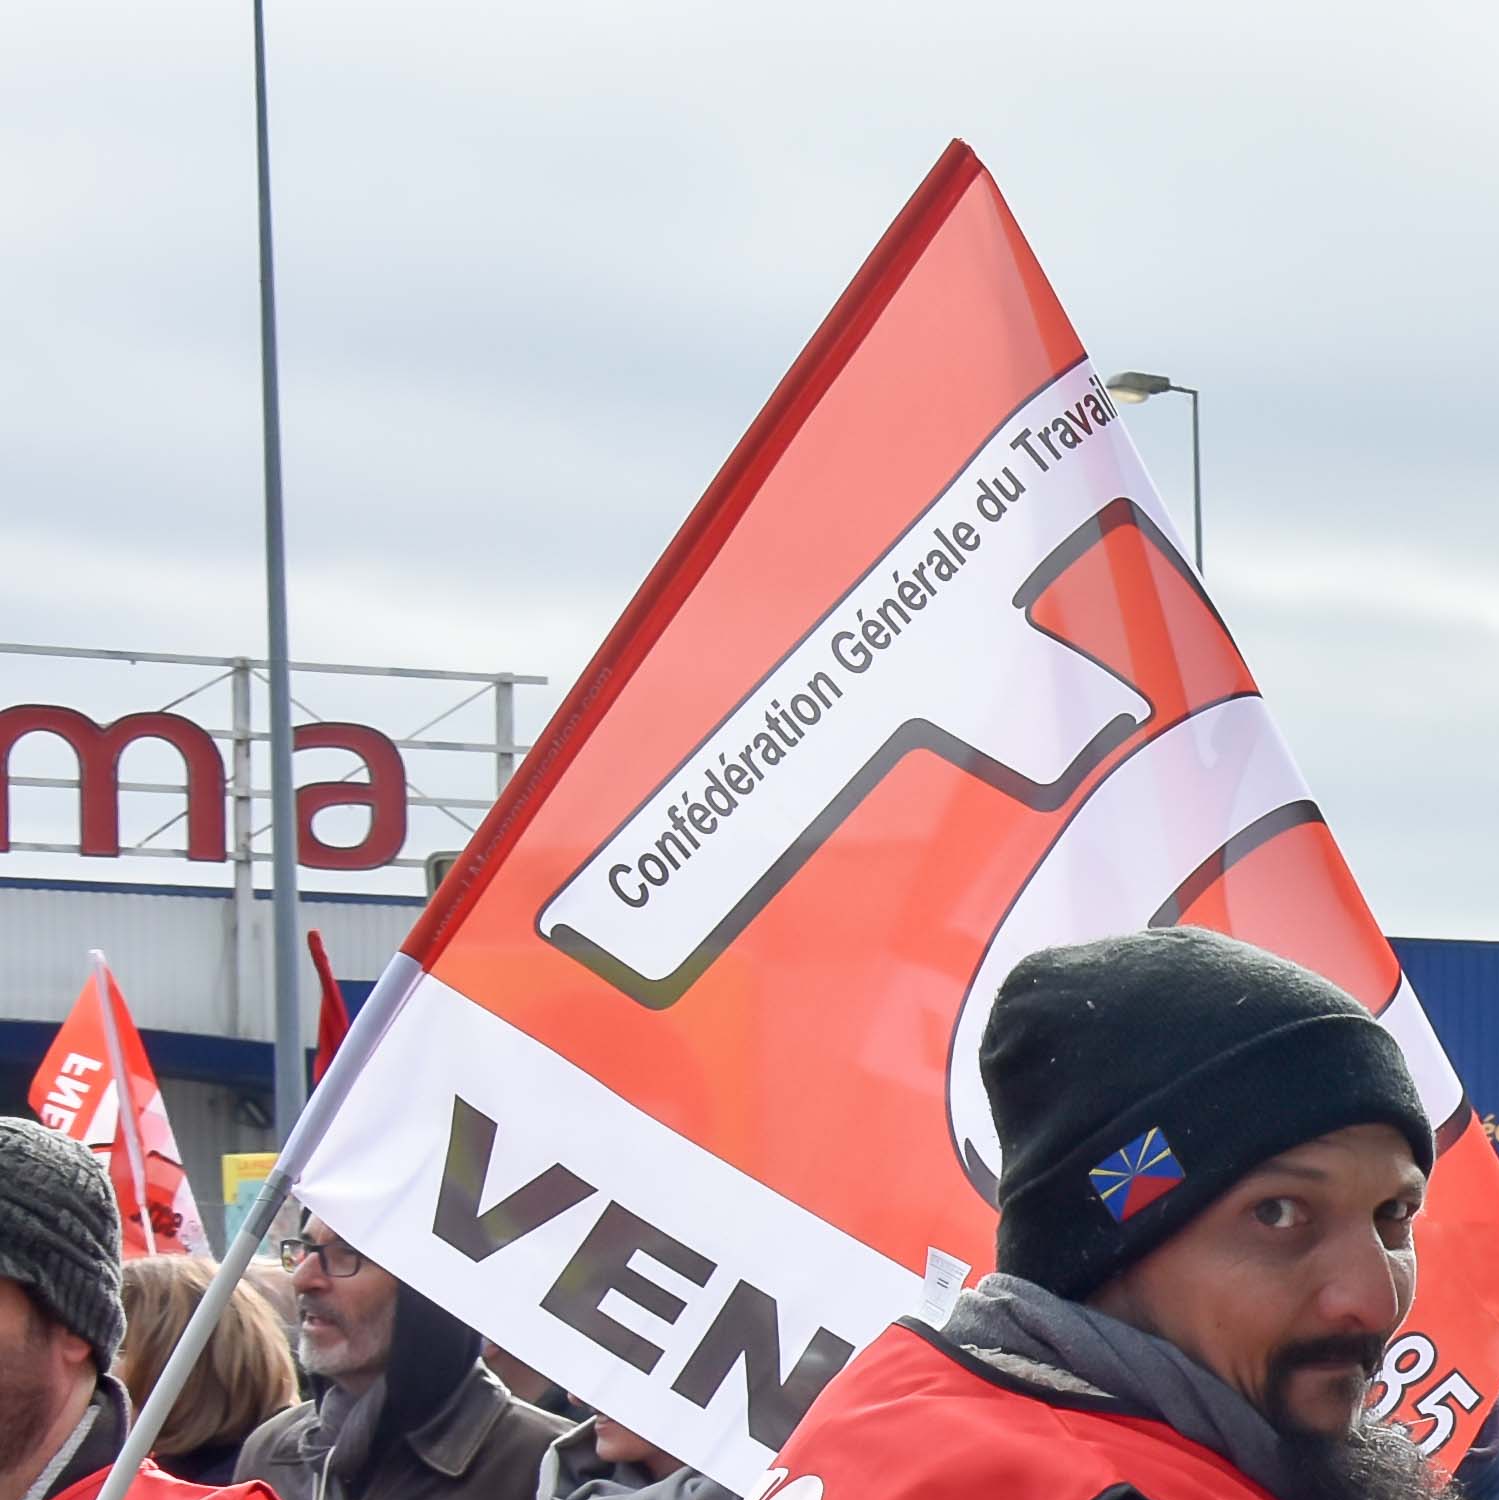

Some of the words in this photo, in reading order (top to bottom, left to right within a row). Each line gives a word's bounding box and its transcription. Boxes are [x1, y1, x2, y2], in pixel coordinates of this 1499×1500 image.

[608, 671, 843, 908] Confédération
[831, 521, 982, 674] Générale
[977, 467, 1026, 523] du
[1009, 375, 1118, 471] Travail
[432, 1094, 856, 1452] VEN
[1361, 1331, 1483, 1458] 85
